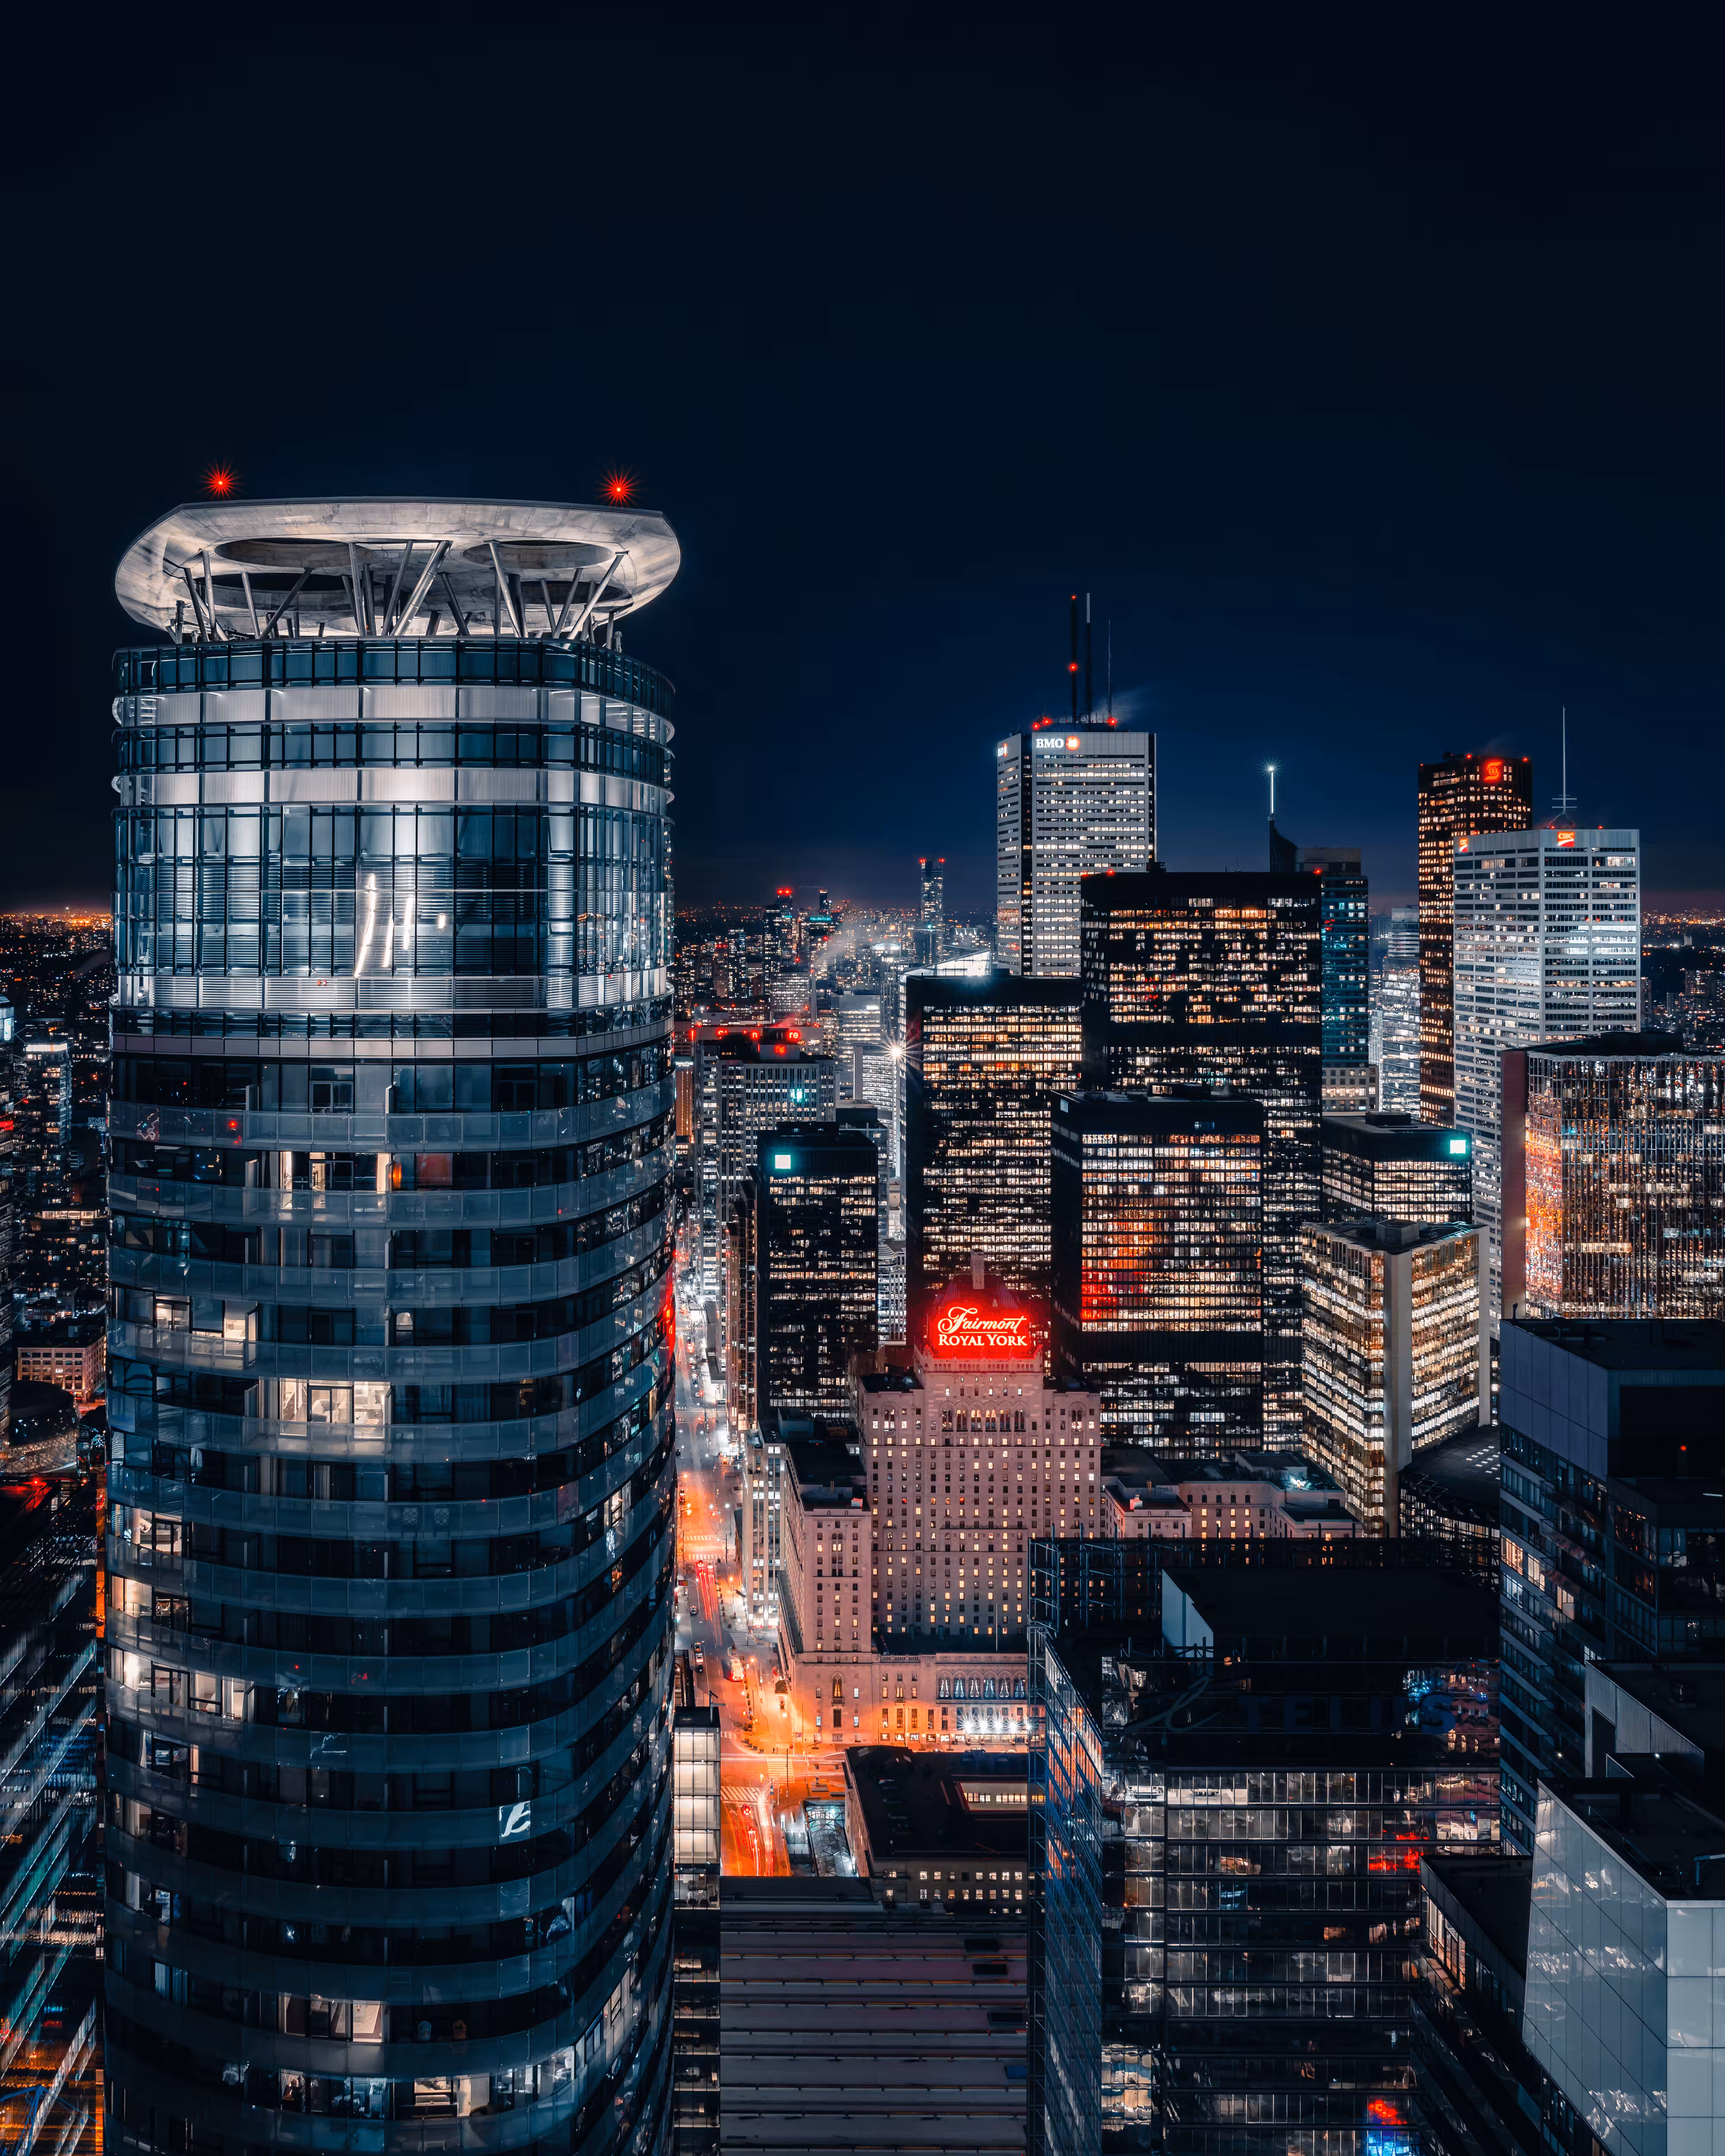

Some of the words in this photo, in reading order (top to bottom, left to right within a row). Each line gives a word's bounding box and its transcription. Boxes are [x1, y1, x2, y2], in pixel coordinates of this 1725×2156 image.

[1036, 739, 1064, 748] BMO
[938, 1307, 1027, 1334] Fairmont
[938, 1334, 985, 1346] ROYAL
[986, 1334, 1027, 1346] YORK
[1237, 1695, 1455, 1733] TELUS
